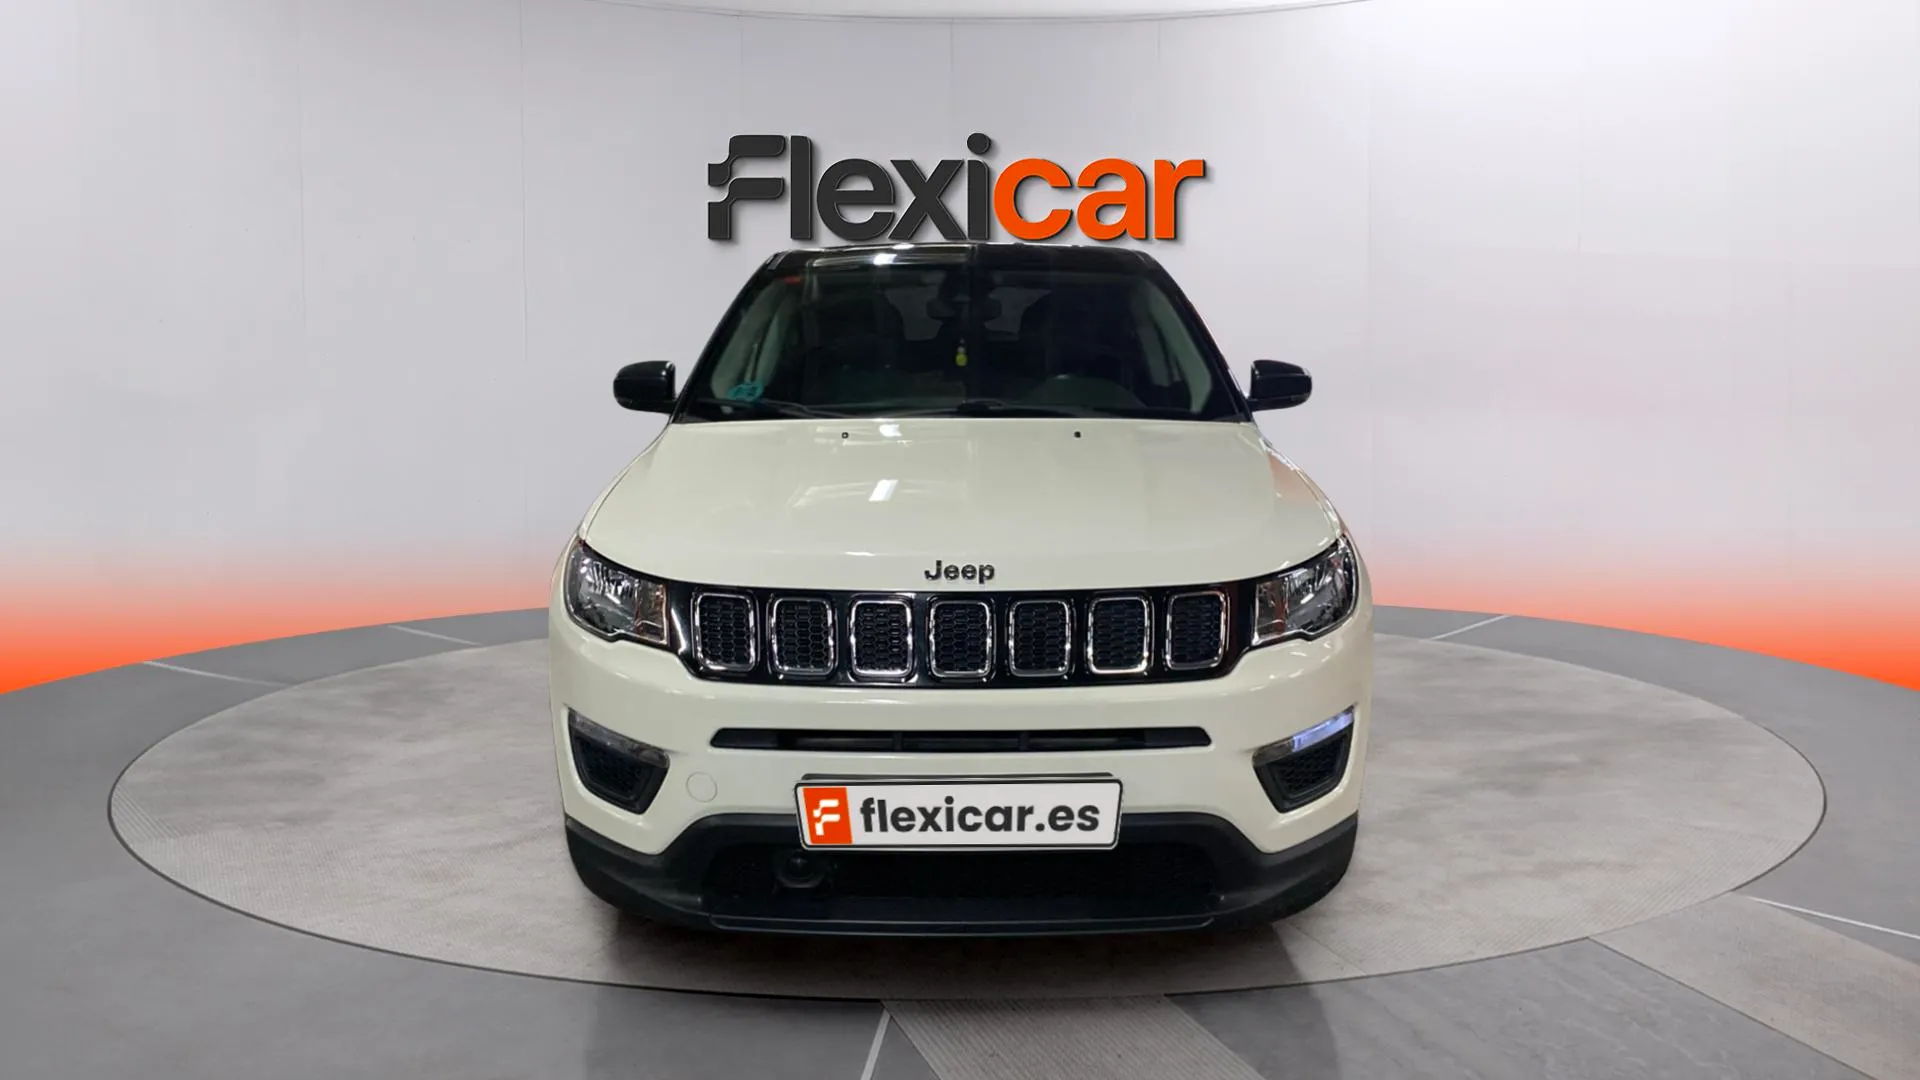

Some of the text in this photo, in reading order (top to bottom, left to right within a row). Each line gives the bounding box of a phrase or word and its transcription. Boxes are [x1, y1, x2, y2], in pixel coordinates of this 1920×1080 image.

[708, 133, 1206, 240] Flexicar
[924, 560, 995, 584] Jeep
[860, 796, 1100, 833] flexicar.es
